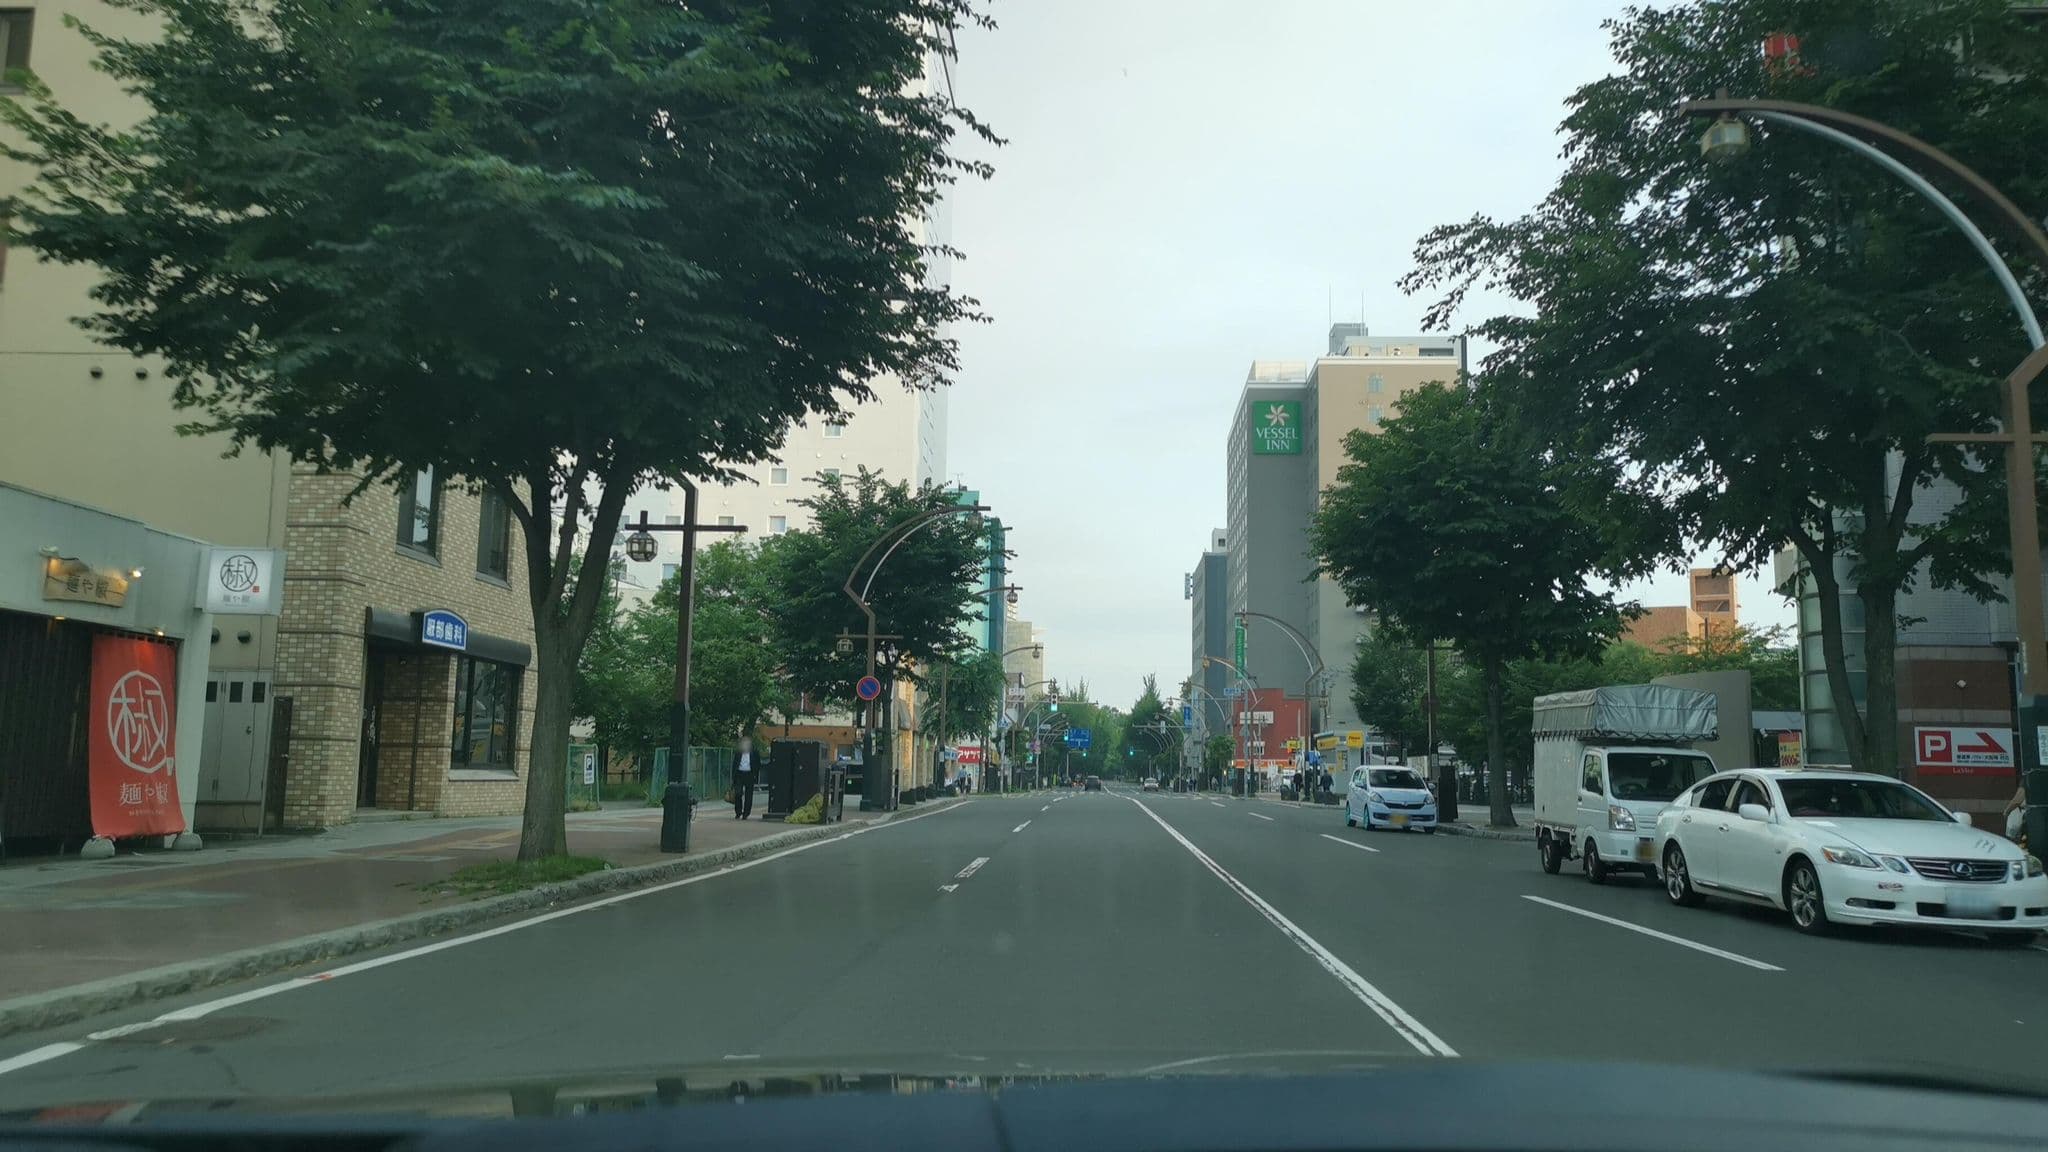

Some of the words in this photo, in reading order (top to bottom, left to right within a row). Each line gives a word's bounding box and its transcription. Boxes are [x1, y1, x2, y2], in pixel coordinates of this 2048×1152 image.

[1256, 427, 1298, 440] VESSEL
[1266, 440, 1290, 450] INN
[1924, 735, 1947, 758] P
